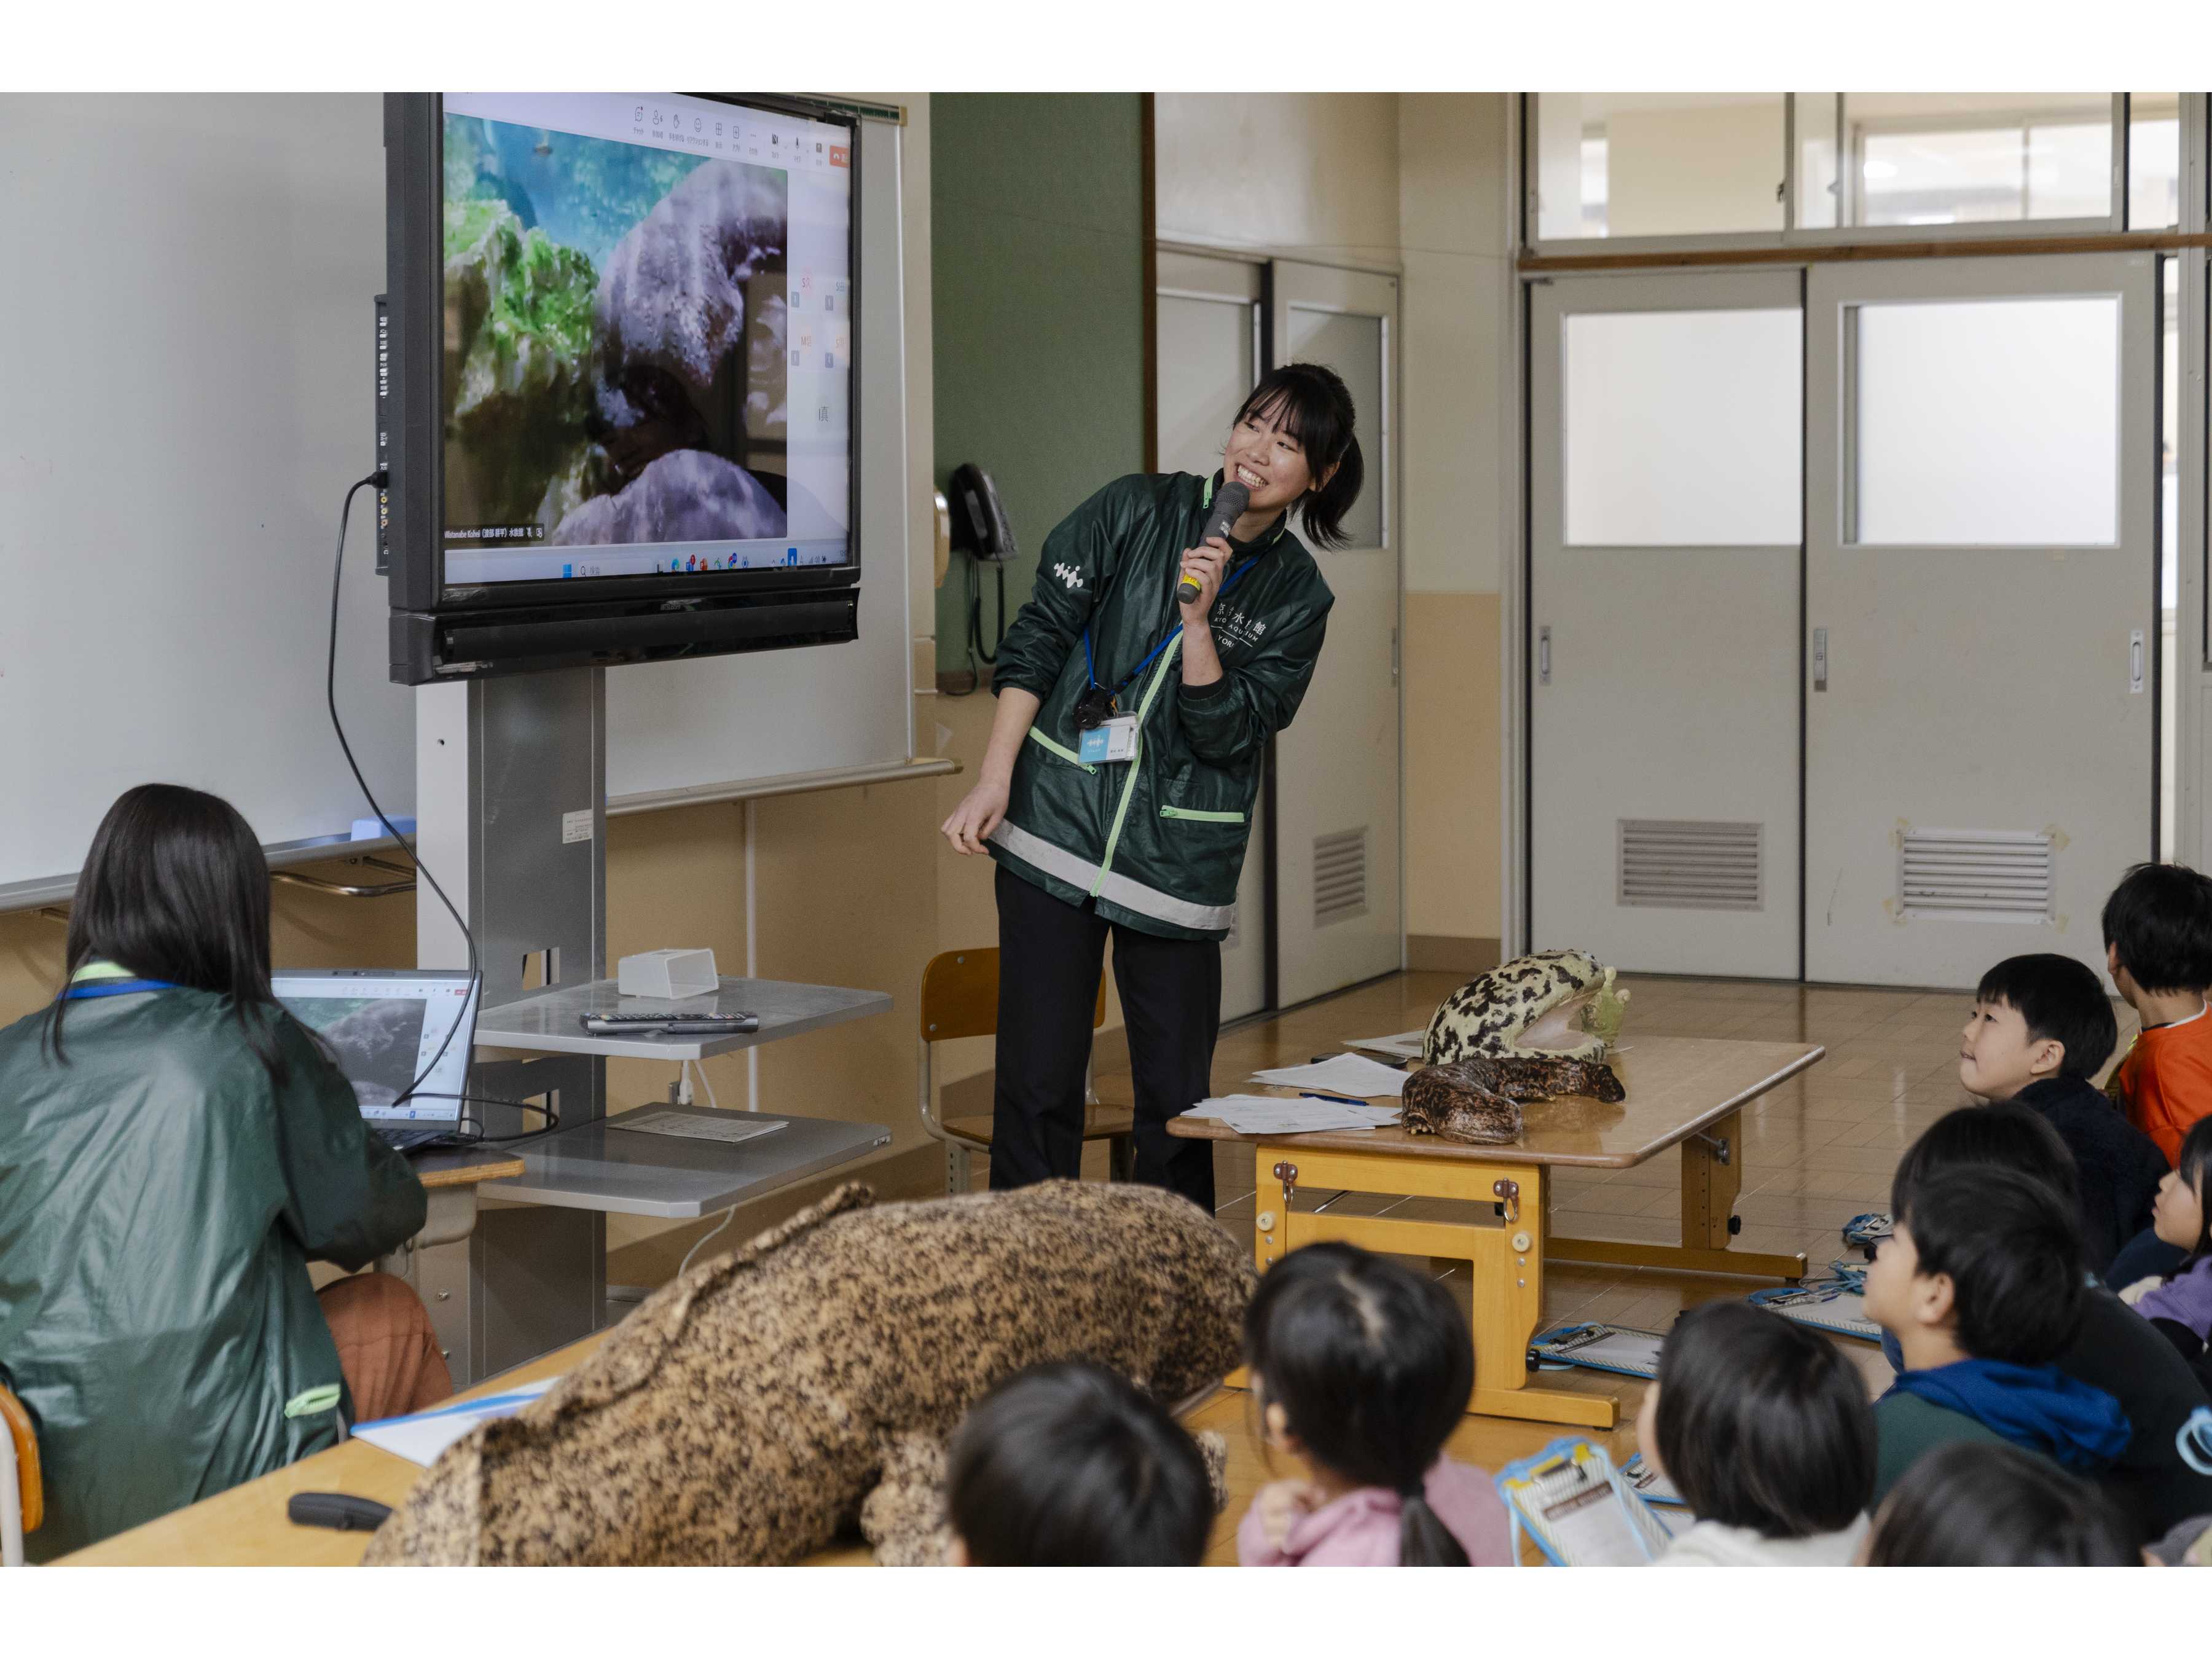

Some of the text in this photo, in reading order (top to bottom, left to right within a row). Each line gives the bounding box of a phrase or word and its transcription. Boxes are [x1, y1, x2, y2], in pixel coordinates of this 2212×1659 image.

[1217, 603, 1266, 635] 京水館
[1228, 624, 1258, 642] AQUIUM
